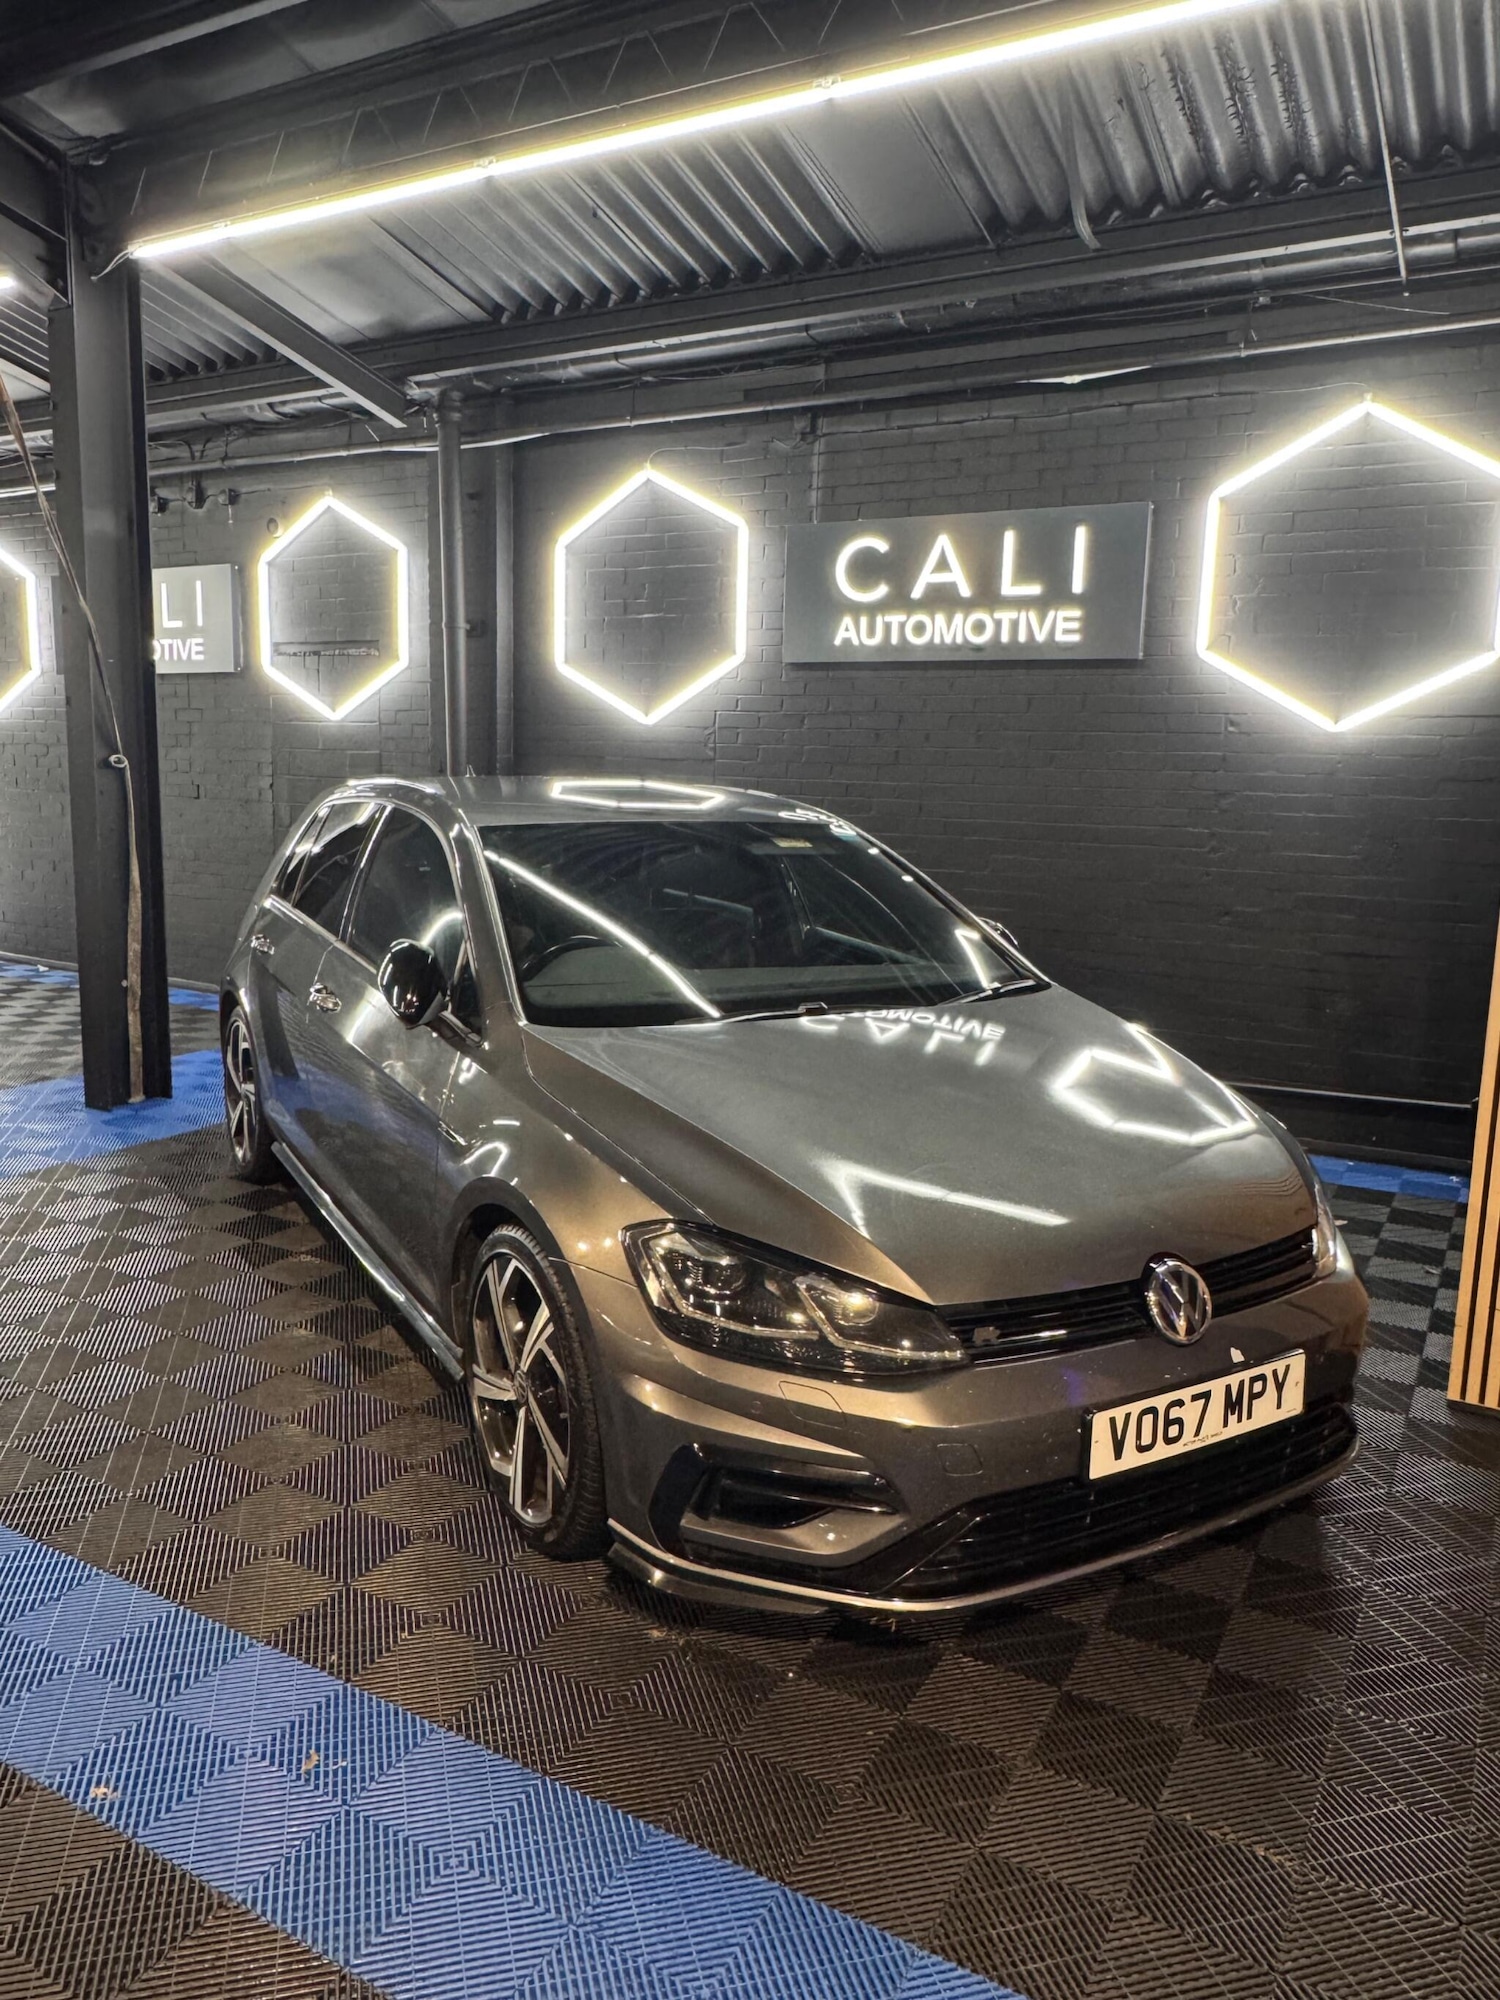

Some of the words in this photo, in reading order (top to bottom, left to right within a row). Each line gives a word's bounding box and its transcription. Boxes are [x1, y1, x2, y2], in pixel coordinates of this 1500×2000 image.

[834, 524, 1087, 603] CALI
[833, 609, 1083, 646] AUTOMOTIVE
[1108, 1388, 1213, 1462] VO67
[1221, 1363, 1291, 1429] MPY
